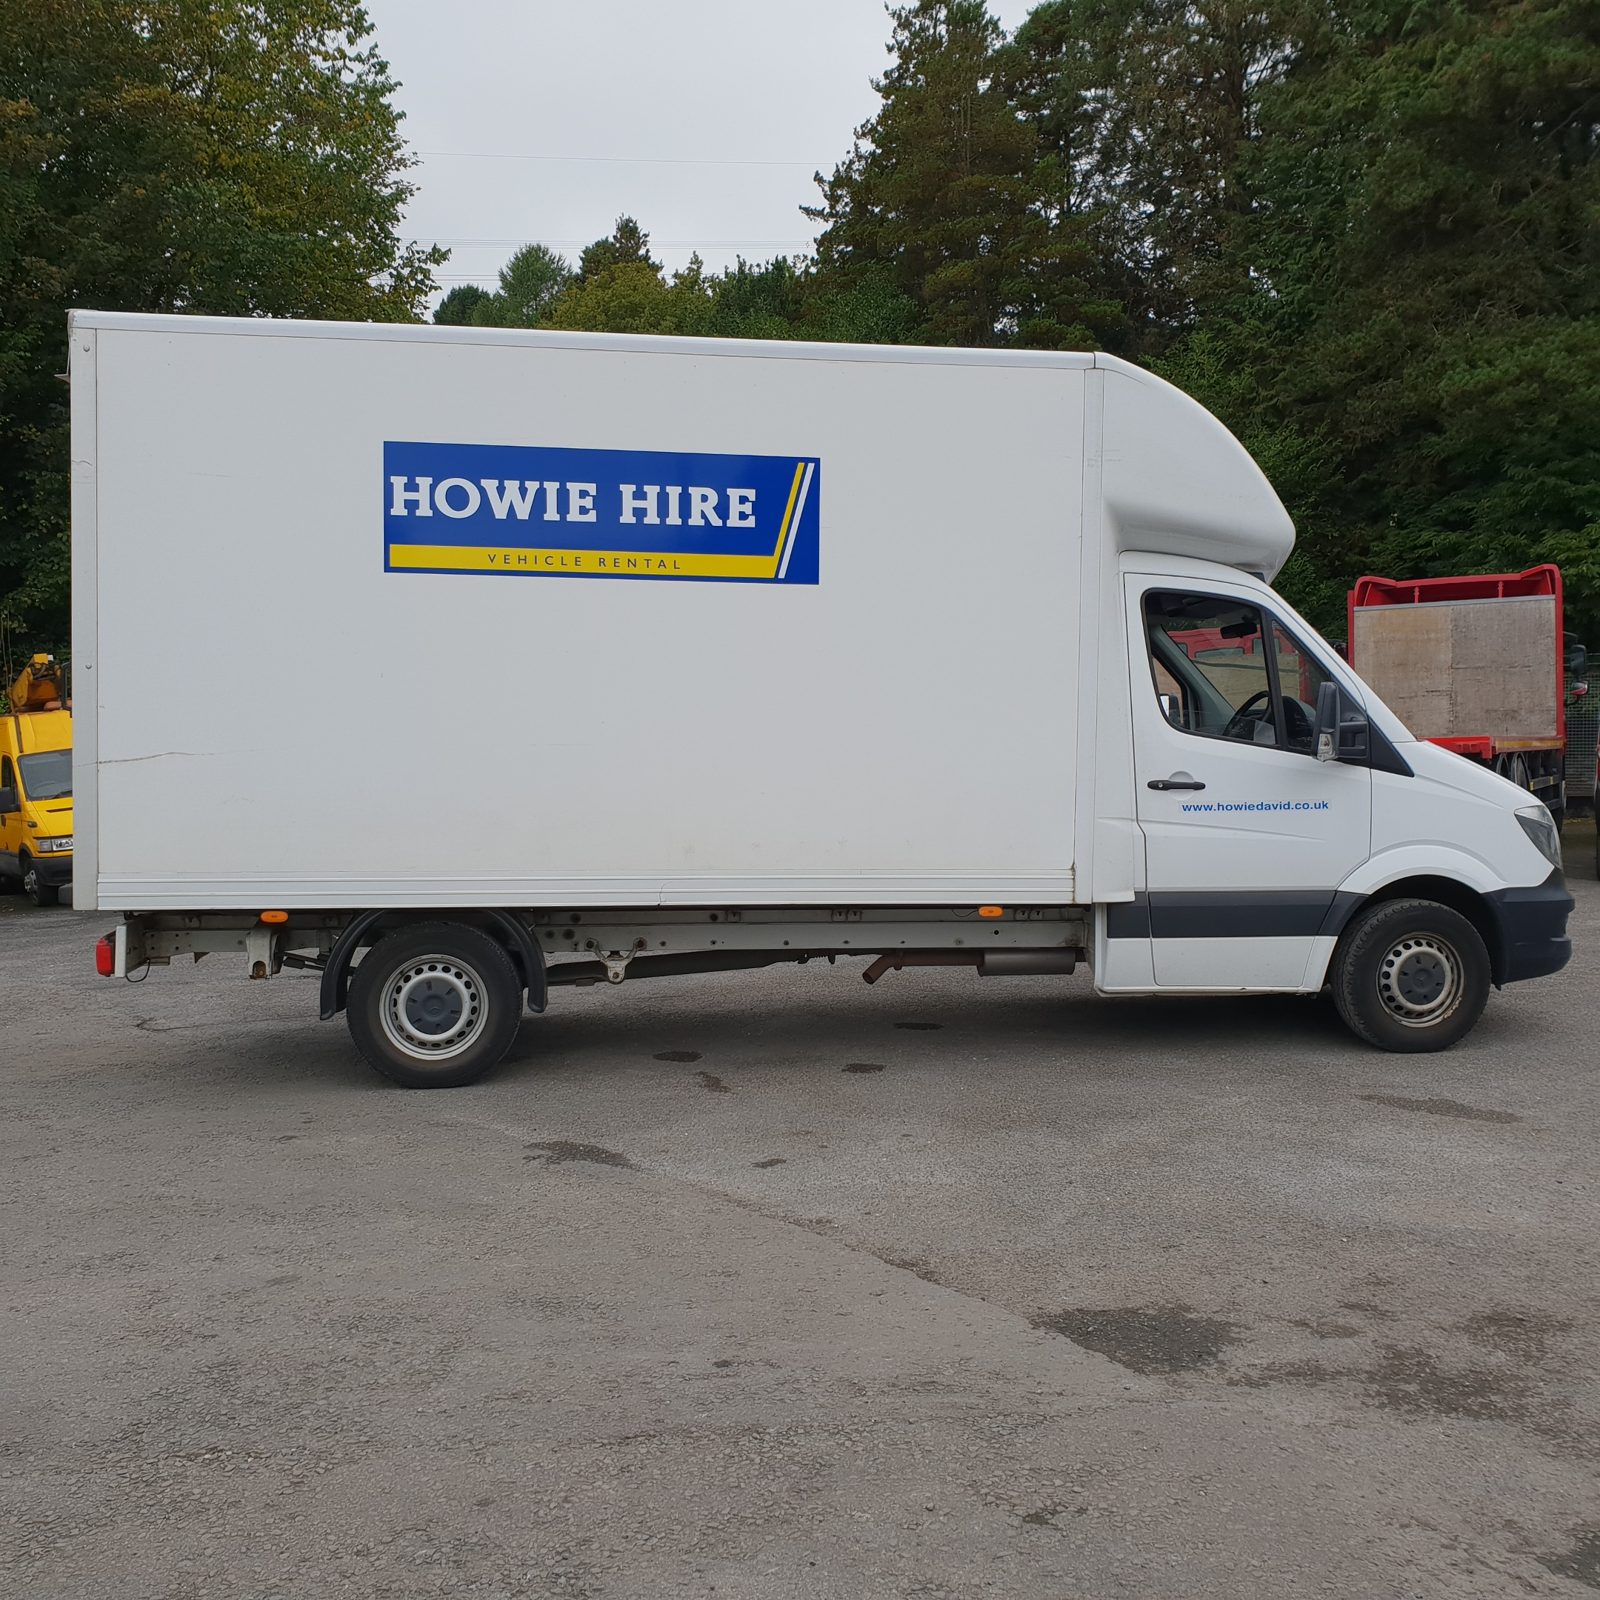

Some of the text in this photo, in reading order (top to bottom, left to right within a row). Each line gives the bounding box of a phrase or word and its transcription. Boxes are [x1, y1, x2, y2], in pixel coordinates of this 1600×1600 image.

[390, 475, 756, 528] HOWIE HIRE
[487, 554, 682, 569] VEHICLE RENTAL
[1181, 800, 1329, 812] www.howiedavid.co.uk
